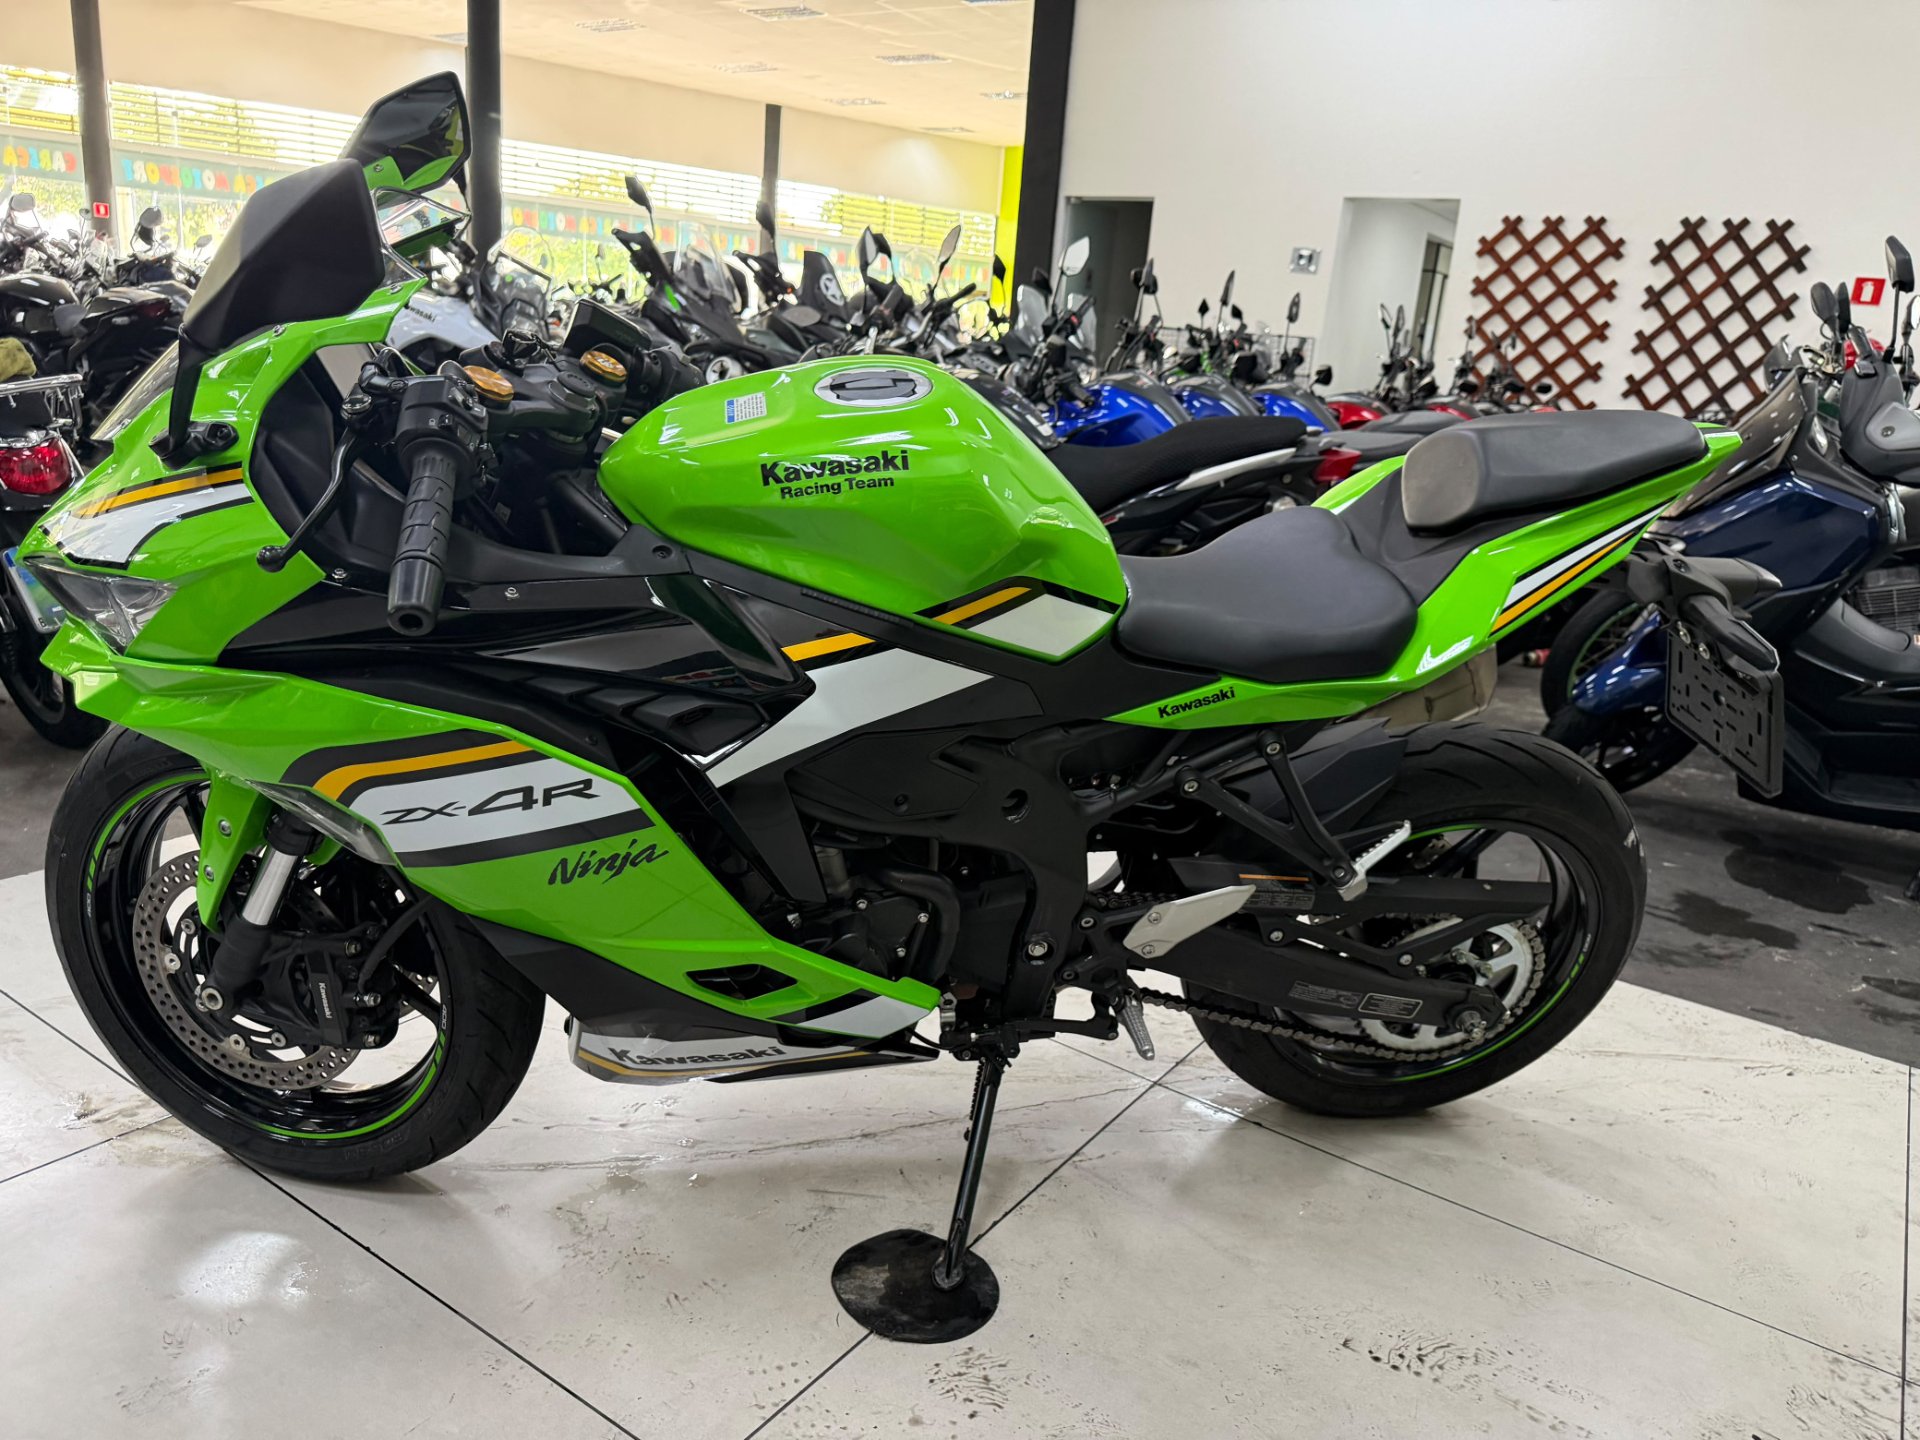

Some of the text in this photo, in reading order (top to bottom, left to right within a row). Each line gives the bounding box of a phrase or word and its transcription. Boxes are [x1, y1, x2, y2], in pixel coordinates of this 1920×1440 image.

[760, 449, 910, 487] Kawasaki
[780, 476, 894, 499] Racing Team
[1157, 686, 1236, 719] Kawasaki
[379, 778, 601, 826] ZX-4R
[547, 838, 670, 886] Ninja
[318, 982, 332, 1018] Kawasaki
[608, 1047, 786, 1065] Kawasaki
